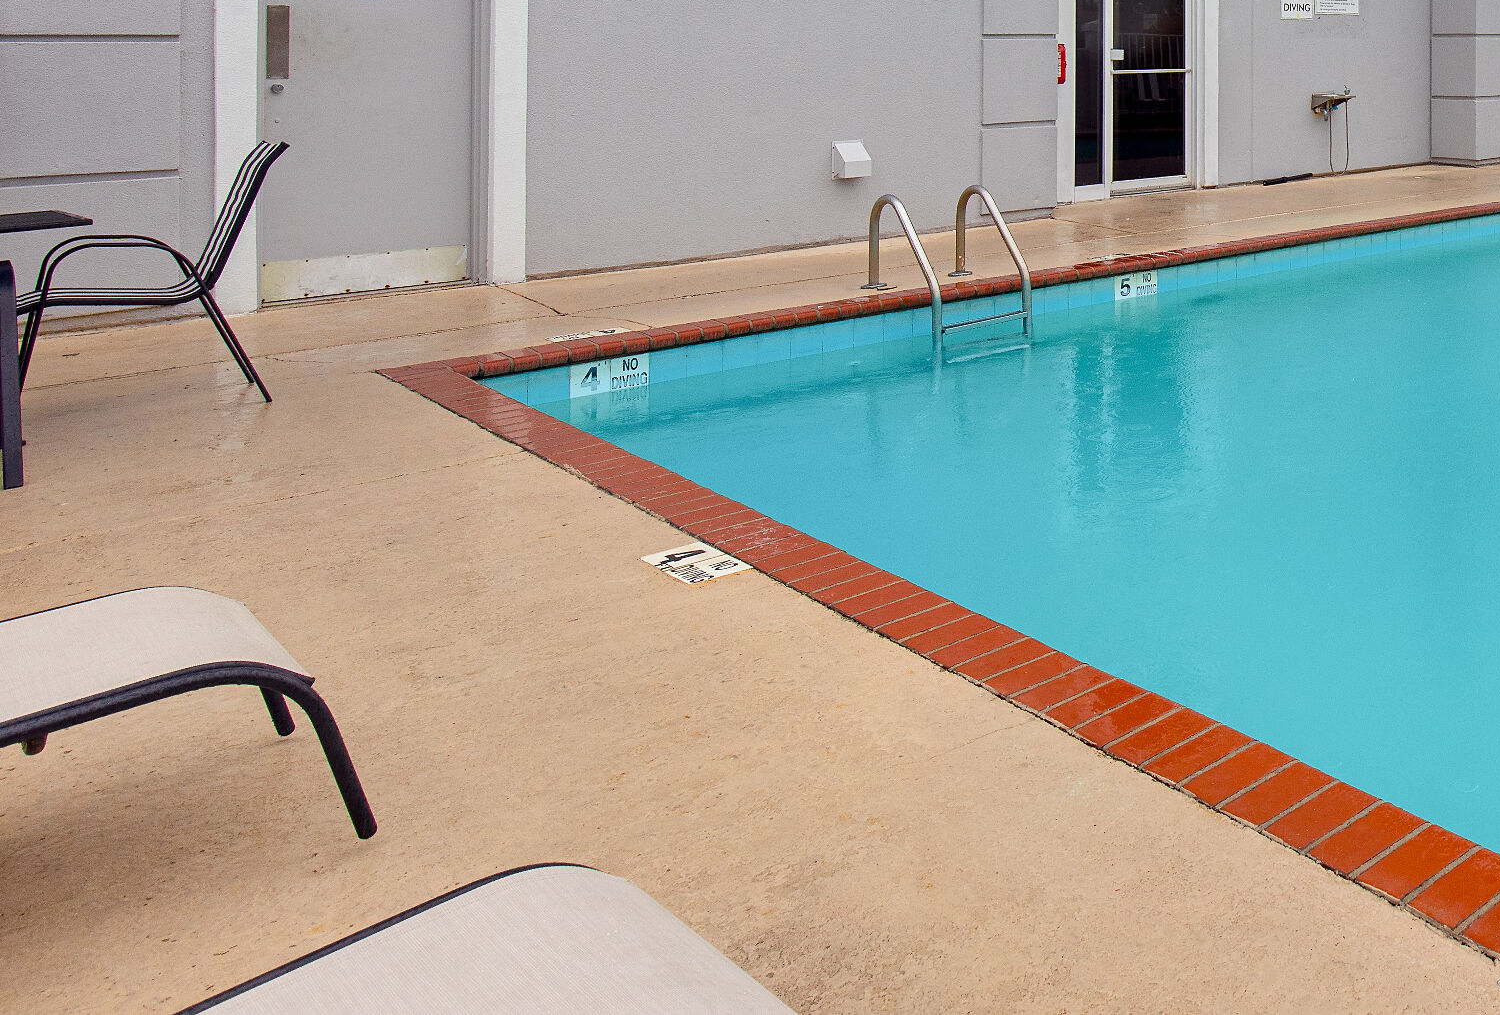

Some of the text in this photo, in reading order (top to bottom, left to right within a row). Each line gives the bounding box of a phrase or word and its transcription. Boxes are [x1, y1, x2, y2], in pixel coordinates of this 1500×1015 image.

[1283, 3, 1311, 12] DIVING
[1142, 272, 1152, 283] NO
[622, 357, 639, 372] NO
[611, 371, 648, 390] DIVING
[658, 549, 706, 565] 4
[709, 559, 738, 571] NO
